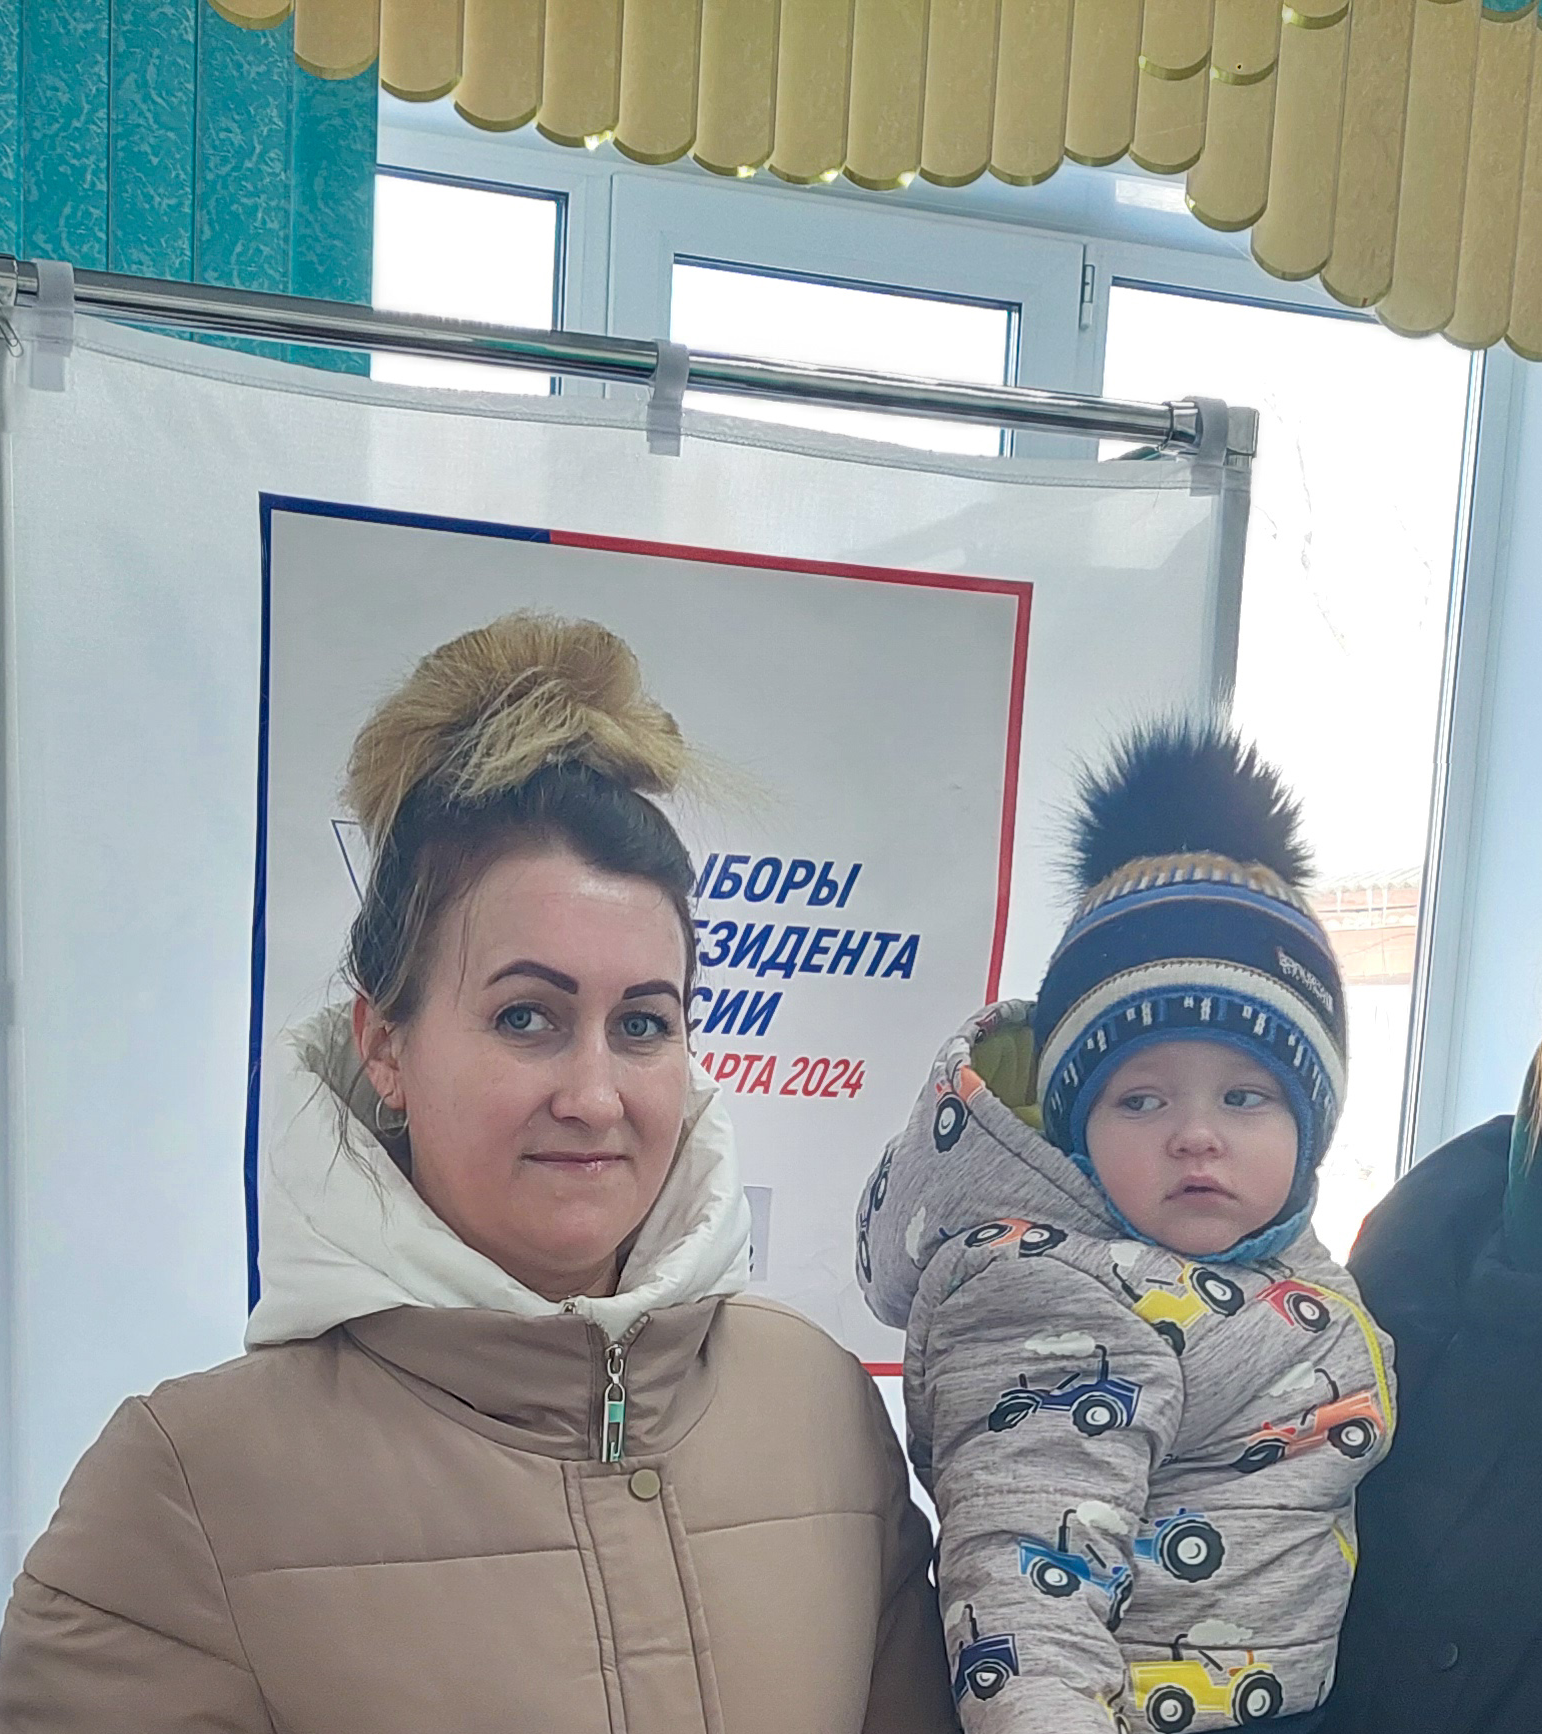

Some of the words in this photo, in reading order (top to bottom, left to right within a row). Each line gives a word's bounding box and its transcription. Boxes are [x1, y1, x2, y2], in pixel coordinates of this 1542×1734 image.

[694, 919, 921, 980] ЗИДЕНТА
[690, 986, 783, 1036] СИИ
[779, 1056, 866, 1099] 2024
